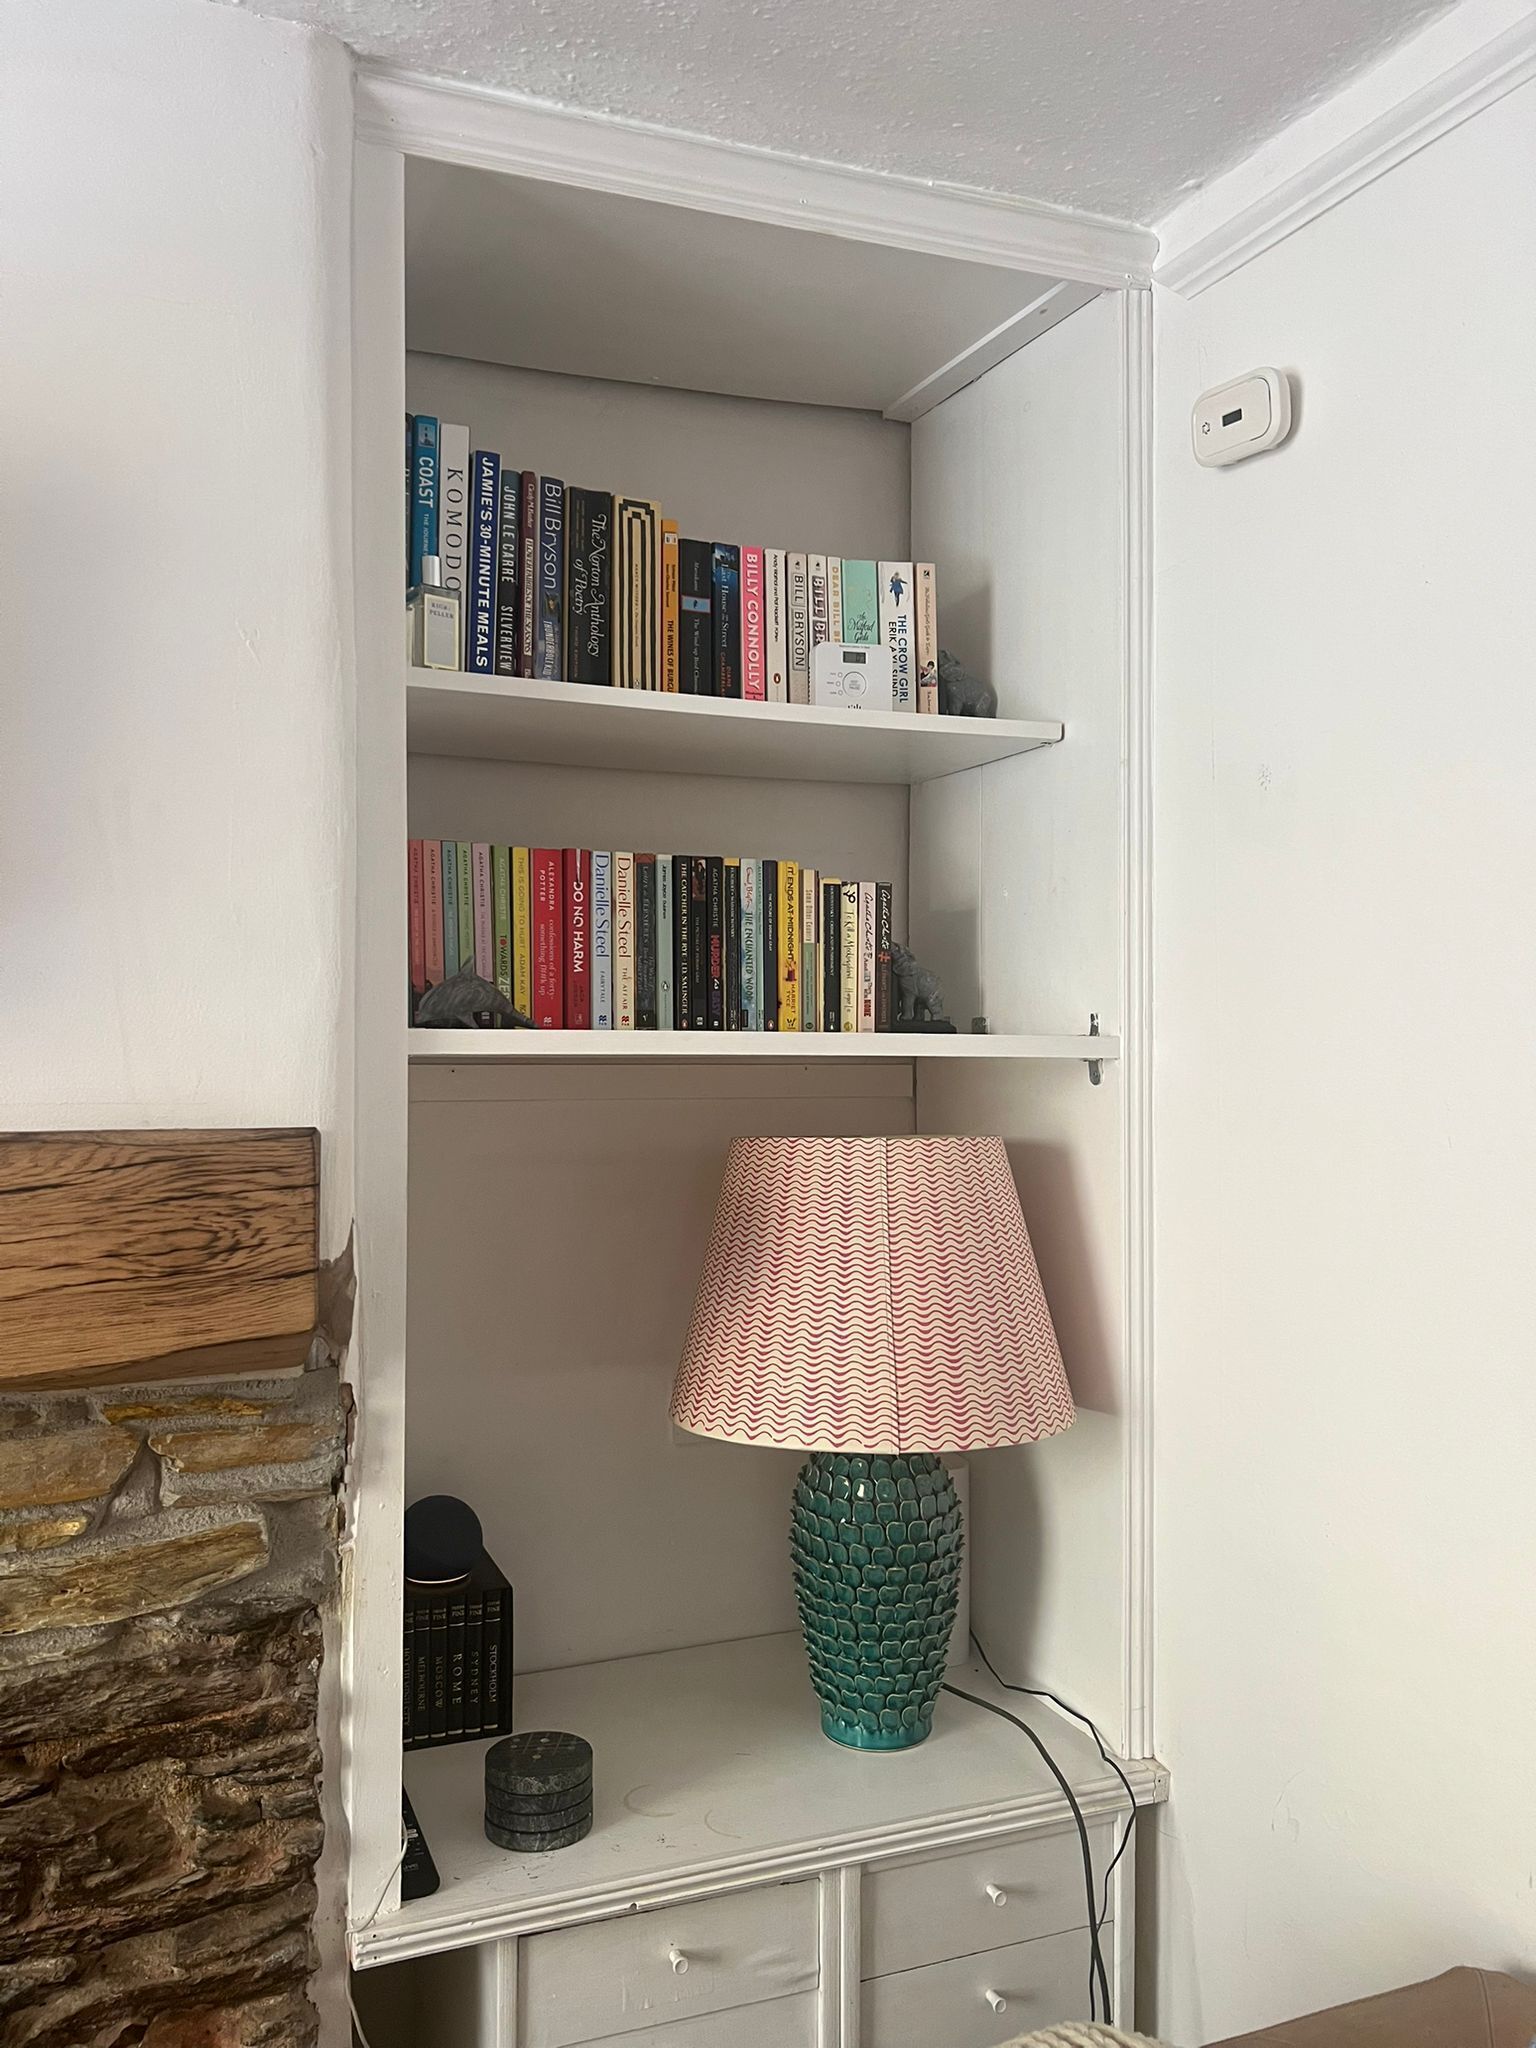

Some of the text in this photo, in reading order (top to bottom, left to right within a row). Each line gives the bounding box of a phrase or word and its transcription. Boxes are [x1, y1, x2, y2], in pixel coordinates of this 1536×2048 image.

[418, 456, 434, 509] COAST
[502, 486, 516, 519] JOHN
[445, 467, 464, 591] KOMODO
[502, 524, 516, 537] LE
[541, 483, 562, 590] Bill Bryson
[476, 457, 495, 667] JAMIE'S 30-MINUTE MEALS
[573, 559, 587, 575] of
[572, 575, 588, 616] Poetry
[581, 513, 607, 657] The Norton Anthology
[721, 585, 730, 613] House
[814, 578, 824, 614] BILL
[667, 620, 675, 633] THE
[746, 553, 761, 690] BILLY CONNOLLY
[794, 575, 805, 667] BILL BRYSON
[833, 601, 841, 625] BILL
[888, 621, 898, 642] ERIK
[500, 605, 514, 671] SILVERVIEW
[667, 634, 675, 656] WINES
[720, 622, 730, 648] Street
[667, 657, 675, 667] OF
[897, 614, 909, 704] THE CROW GIRL
[517, 857, 525, 874] THIS
[539, 869, 547, 902] POTTER
[547, 861, 556, 911] ALEXANDRA
[499, 888, 507, 920] CHRISTIE
[595, 854, 610, 958] Danielle Steel
[616, 857, 632, 959] Danielle Steel
[711, 867, 719, 927] AGATHA CHRISTIE
[787, 877, 795, 901] ENDS
[787, 904, 796, 915] AT
[519, 914, 526, 926] TO
[573, 906, 585, 927] NO
[681, 916, 688, 925] IN
[864, 892, 874, 951] Agatha Christie
[880, 889, 891, 949] Agatha Christie
[548, 919, 557, 961] confessions
[573, 930, 585, 973] HARM
[711, 934, 720, 978] MURDER
[744, 912, 754, 1001] THE ENCHANTED WOOD
[787, 917, 796, 960] MIDNIGHT
[538, 924, 547, 996] something up
[548, 962, 557, 971] of
[621, 968, 629, 981] THE
[498, 976, 511, 1001] ZER
[681, 976, 689, 1015] SALINGER
[711, 991, 720, 1016] EASY
[863, 998, 872, 1017] NONE
[417, 1656, 426, 1711] MELBOURNE
[434, 1655, 444, 1708] MOSCOW
[452, 1653, 463, 1705] ROME
[469, 1650, 480, 1704] SYDNEY
[488, 1644, 498, 1703] STOCKHOLM
